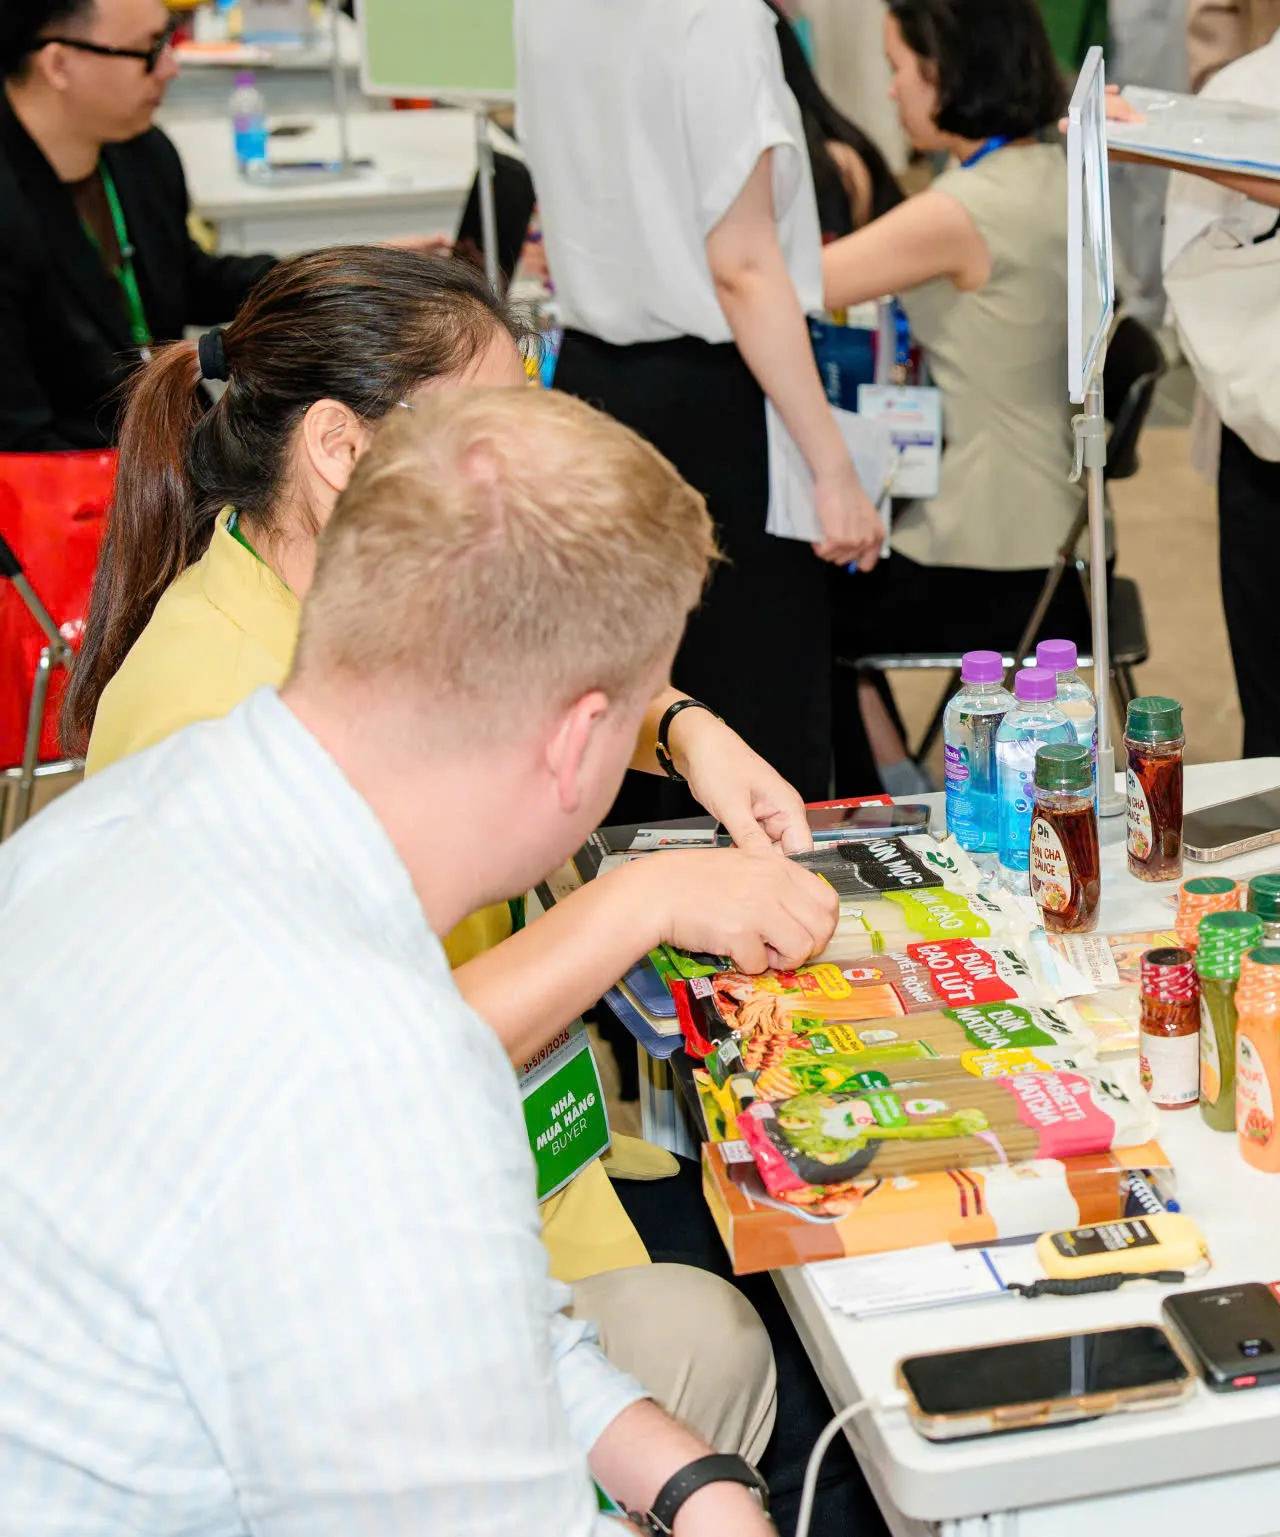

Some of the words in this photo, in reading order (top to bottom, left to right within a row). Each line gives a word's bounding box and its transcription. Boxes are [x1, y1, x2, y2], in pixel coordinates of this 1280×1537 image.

[1034, 858, 1056, 877] SAUCE
[1044, 848, 1062, 861] CHA
[917, 944, 955, 969] GẠO
[956, 952, 998, 980] BÚN
[935, 971, 976, 1001] LỨT
[951, 1007, 1012, 1049] MATCHA
[987, 1009, 1031, 1033] BÚN
[551, 1090, 576, 1120] NHÀ
[536, 1122, 562, 1151] MUA
[564, 1092, 596, 1125] HÀNG
[551, 1117, 589, 1156] BUYER
